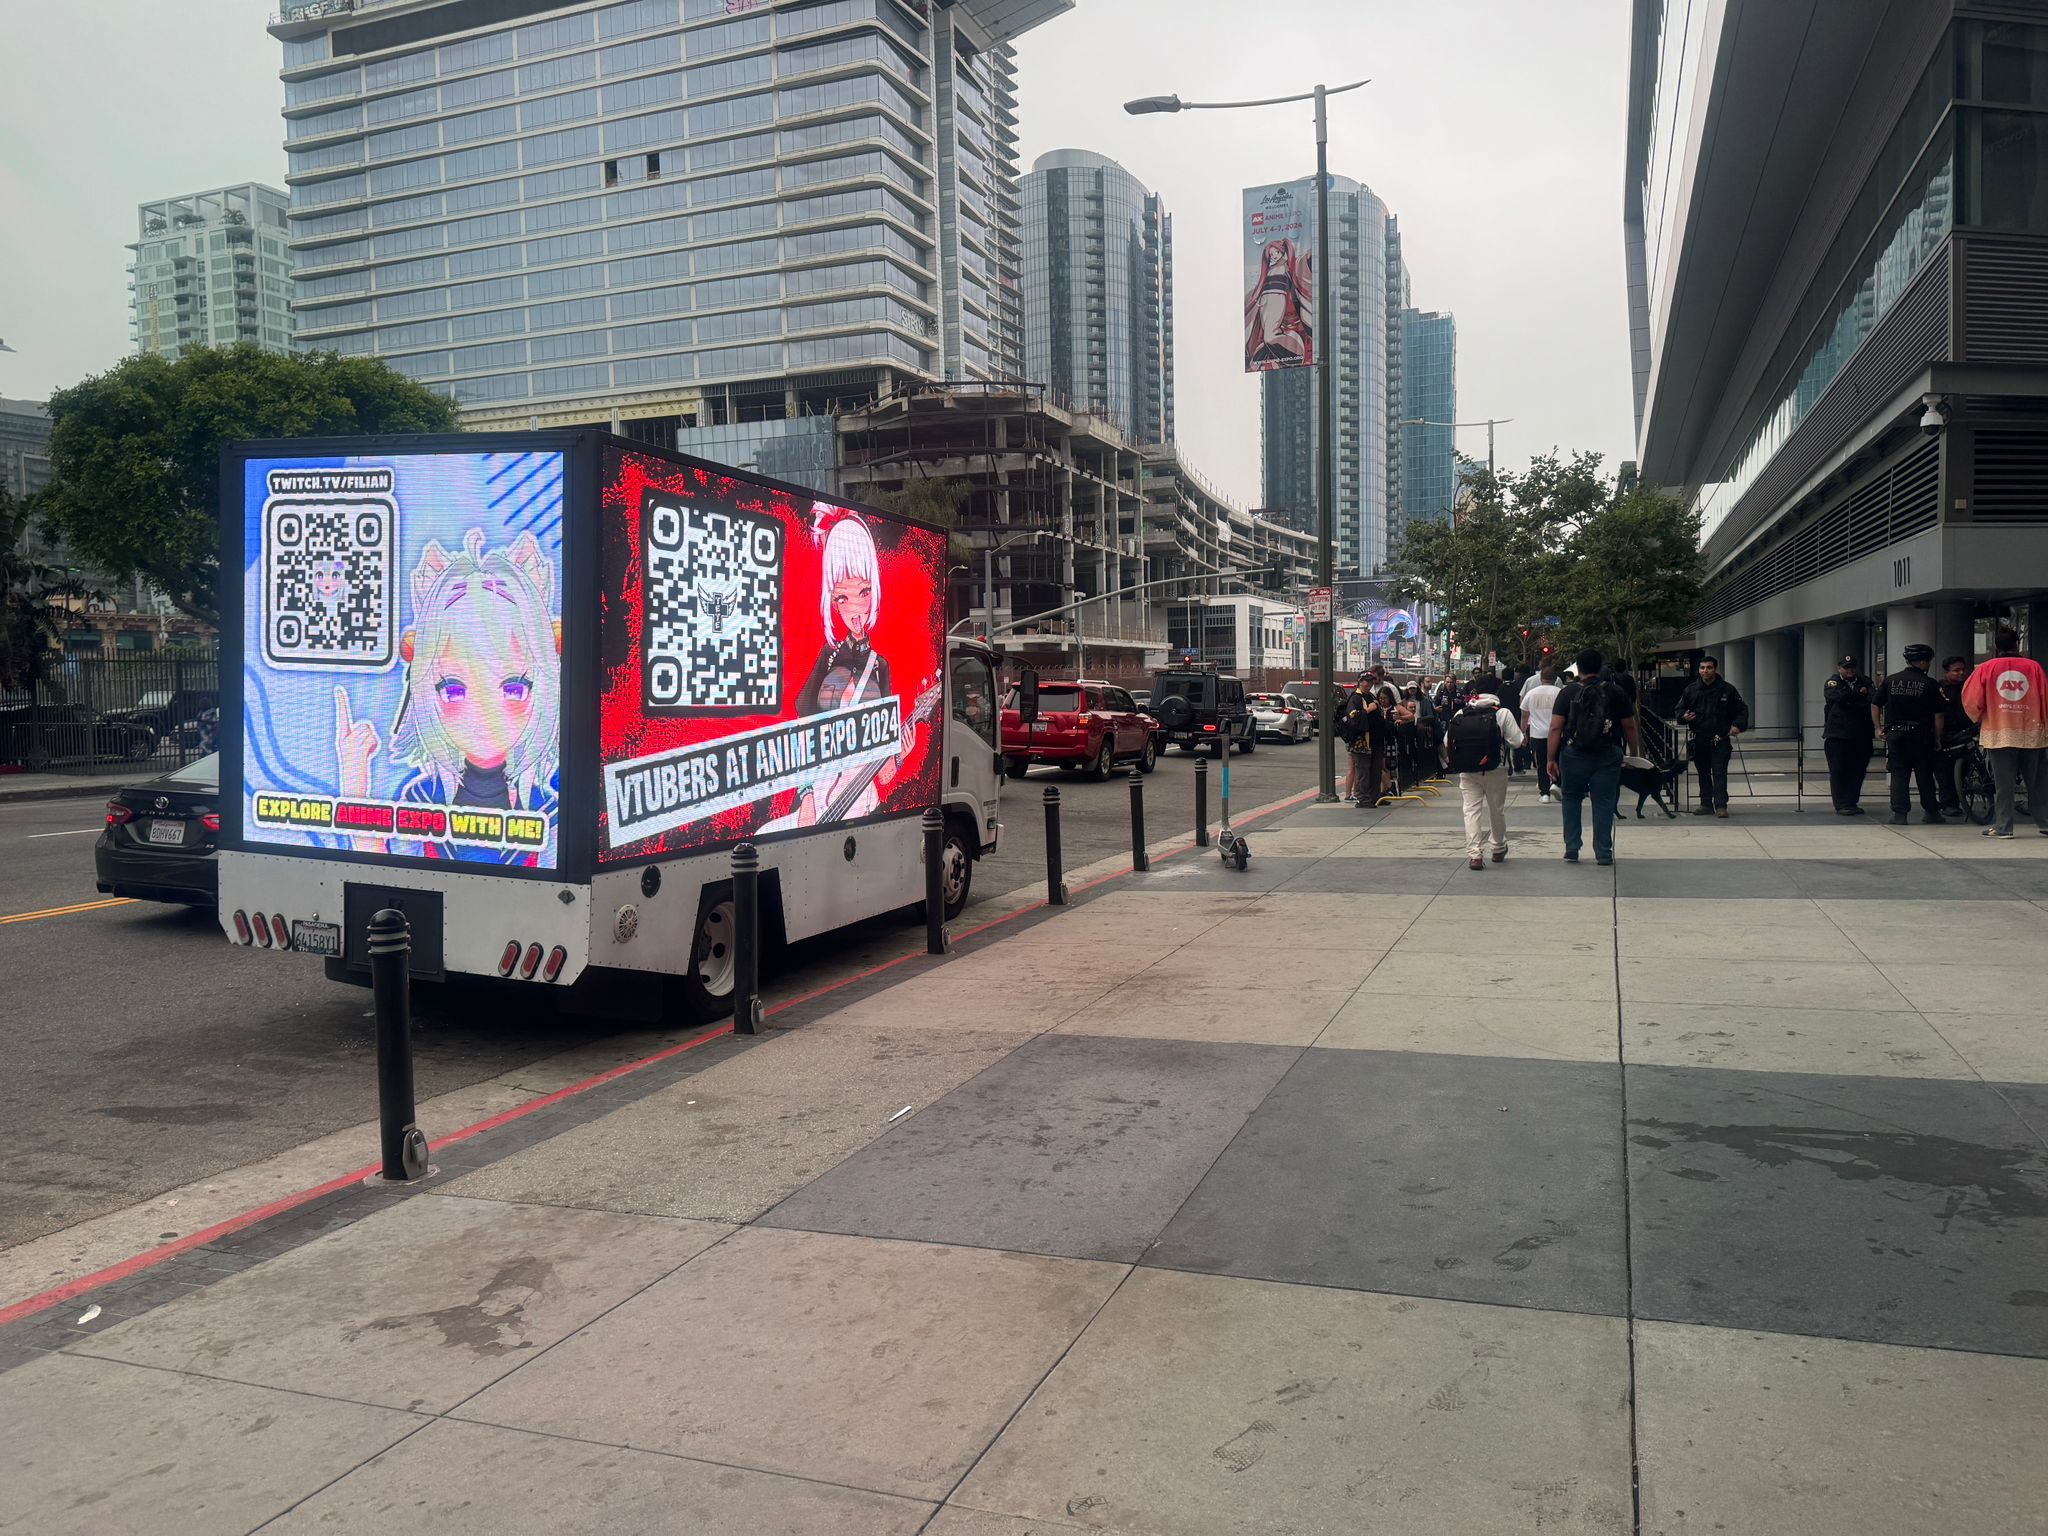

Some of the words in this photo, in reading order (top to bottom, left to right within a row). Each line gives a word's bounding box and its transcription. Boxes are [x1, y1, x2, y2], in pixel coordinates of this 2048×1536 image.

[1265, 213, 1284, 221] ANIME
[1252, 226, 1268, 235] JULY
[1285, 222, 1303, 231] 2024
[272, 475, 389, 490] TWITCH.TV/FILIAN
[1893, 556, 1911, 588] 1011
[1891, 680, 1904, 688] L.A.
[1907, 680, 1925, 690] LIVE
[2000, 680, 2024, 692] AX
[1890, 687, 1923, 698] SECURITY
[615, 753, 719, 822] VTUBERS
[726, 744, 749, 789] AT
[756, 728, 816, 779] ANIME
[820, 717, 857, 759] EXPO
[861, 706, 899, 748] 2024
[259, 797, 332, 821] EXPLORE
[336, 804, 393, 828] ANIME
[397, 810, 445, 832] EXPO
[451, 813, 502, 836] WITH
[507, 818, 543, 840] ME!
